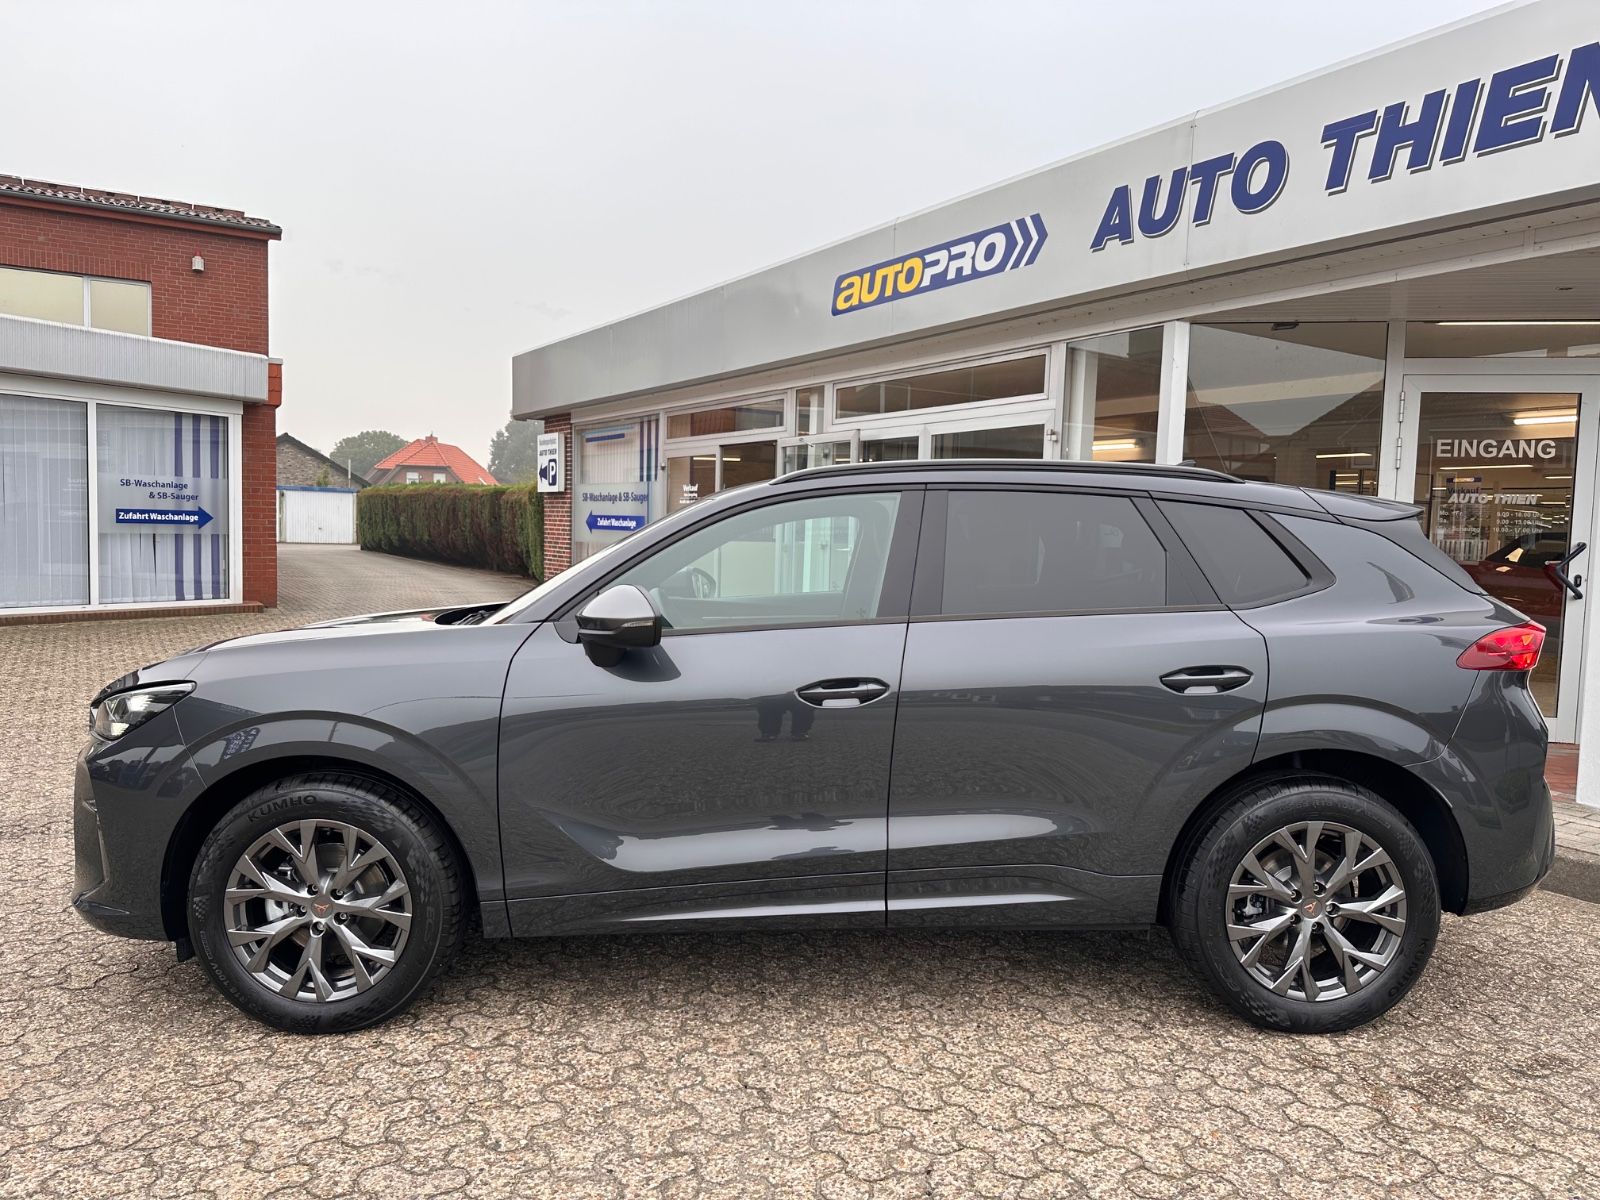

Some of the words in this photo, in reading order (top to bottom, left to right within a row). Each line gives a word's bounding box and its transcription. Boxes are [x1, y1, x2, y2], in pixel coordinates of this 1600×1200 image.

[1090, 139, 1290, 252] AUTO
[1436, 439, 1556, 459] EINGANG
[550, 461, 556, 484] P
[120, 479, 188, 491] SB-Waschanlage
[157, 492, 199, 502] SB-Sauger
[582, 492, 617, 504] SB-Waschanlage
[623, 492, 648, 504] SB-Sauger
[1448, 493, 1489, 504] AUTO
[1494, 494, 1539, 505] THIEN
[119, 512, 149, 520] Zufahrt
[150, 513, 198, 522] Waschanlage
[597, 517, 609, 525] Zufahrt
[610, 518, 636, 529] Waschanlage
[247, 794, 316, 823] KUMHO
